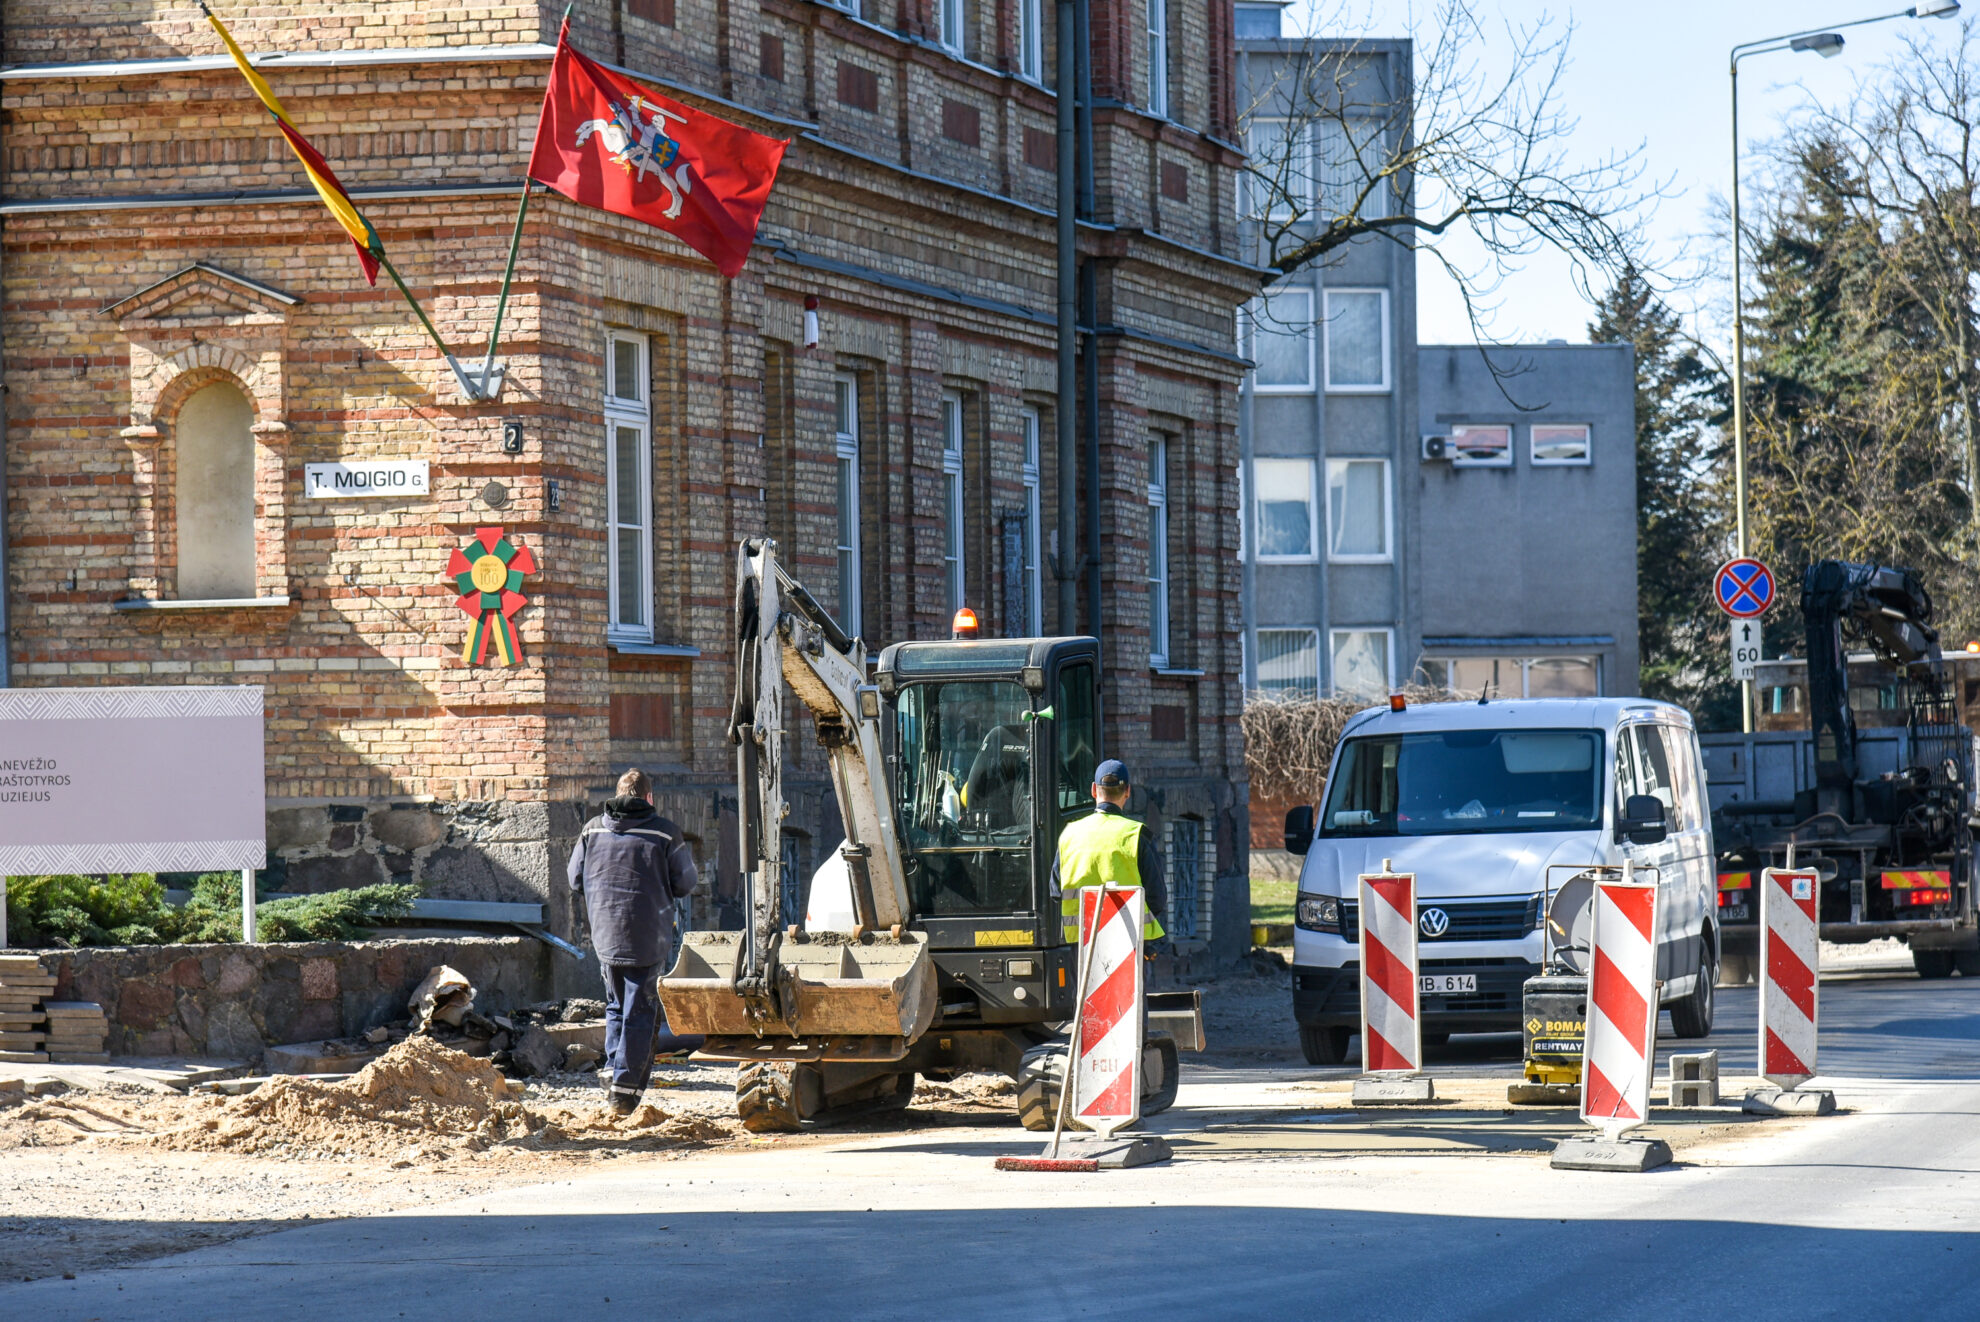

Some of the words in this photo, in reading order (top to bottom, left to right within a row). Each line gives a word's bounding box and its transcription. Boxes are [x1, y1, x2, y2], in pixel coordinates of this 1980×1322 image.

[507, 428, 516, 448] 2
[312, 472, 327, 488] T.
[335, 471, 405, 487] MOIGIO
[412, 475, 423, 486] G.
[480, 573, 498, 585] 100
[1737, 647, 1758, 662] 60
[1742, 668, 1753, 676] m
[1445, 976, 1474, 991] 614
[1534, 1042, 1582, 1051] RENTWAY
